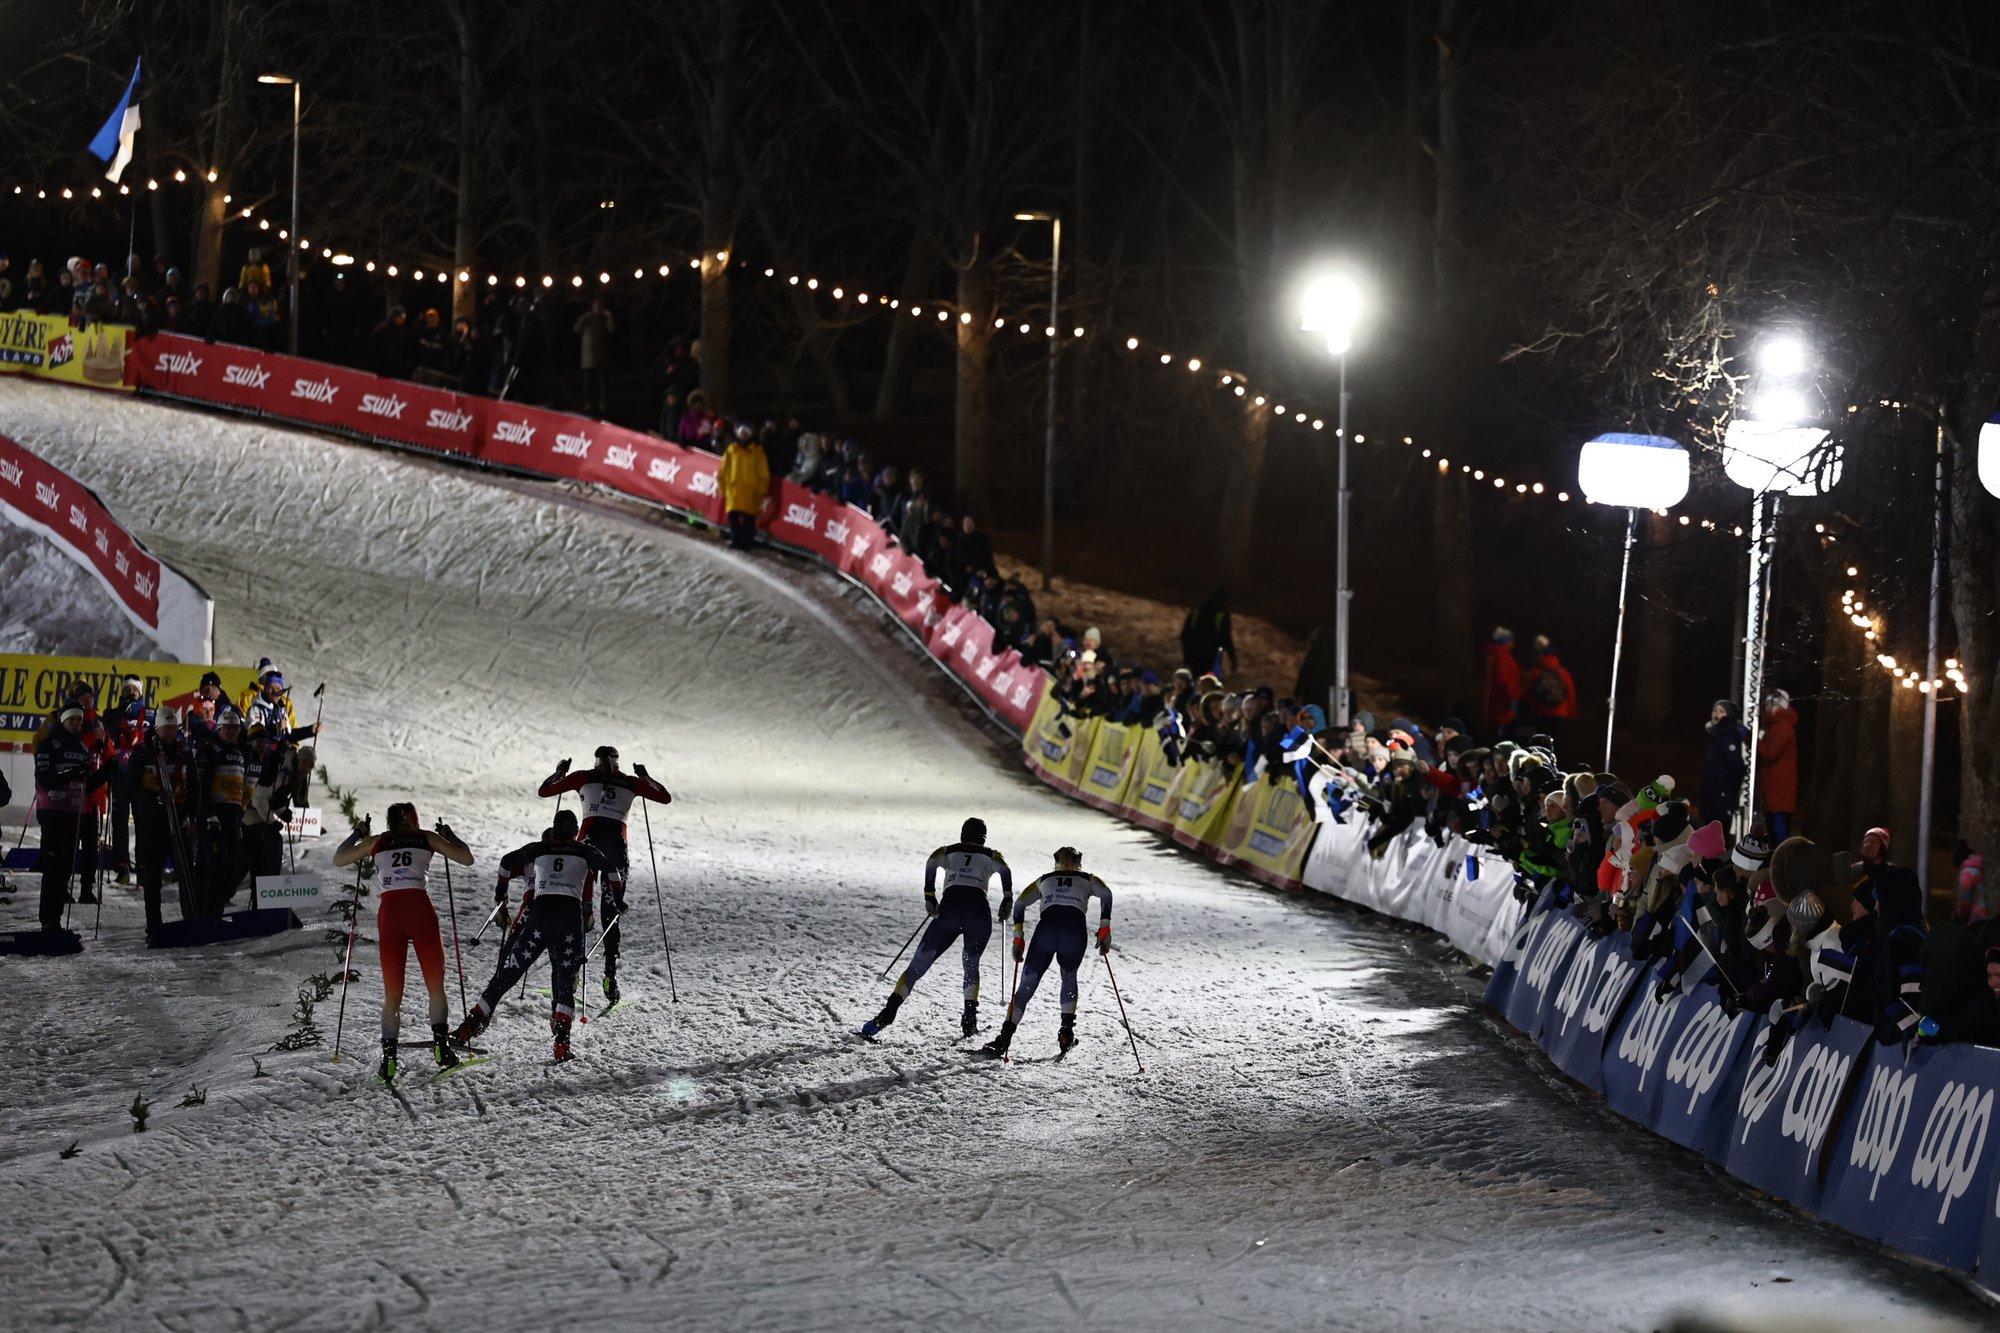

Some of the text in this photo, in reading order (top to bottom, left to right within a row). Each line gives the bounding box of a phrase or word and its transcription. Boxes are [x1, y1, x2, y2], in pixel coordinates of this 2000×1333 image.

[155, 352, 203, 376] swix
[223, 364, 270, 389] swix
[291, 378, 339, 404] swix
[358, 393, 408, 419] swix
[426, 408, 474, 433] swix
[492, 419, 536, 446] swix
[552, 431, 592, 458] swix
[604, 443, 638, 471] swix
[0, 460, 24, 488] swix
[648, 457, 681, 484] swix
[35, 482, 60, 512] swix
[69, 504, 88, 535] swix
[783, 503, 818, 530] swix
[0, 667, 29, 707] LE
[392, 851, 413, 867] 26
[554, 858, 564, 872] 6
[964, 855, 972, 866] 7
[260, 887, 319, 898] COACHING
[1056, 878, 1073, 887] 14
[1667, 1001, 1743, 1115] coop
[1782, 1043, 1850, 1175] coop
[1851, 1064, 1917, 1201] coop
[1911, 1080, 1994, 1224] coop
